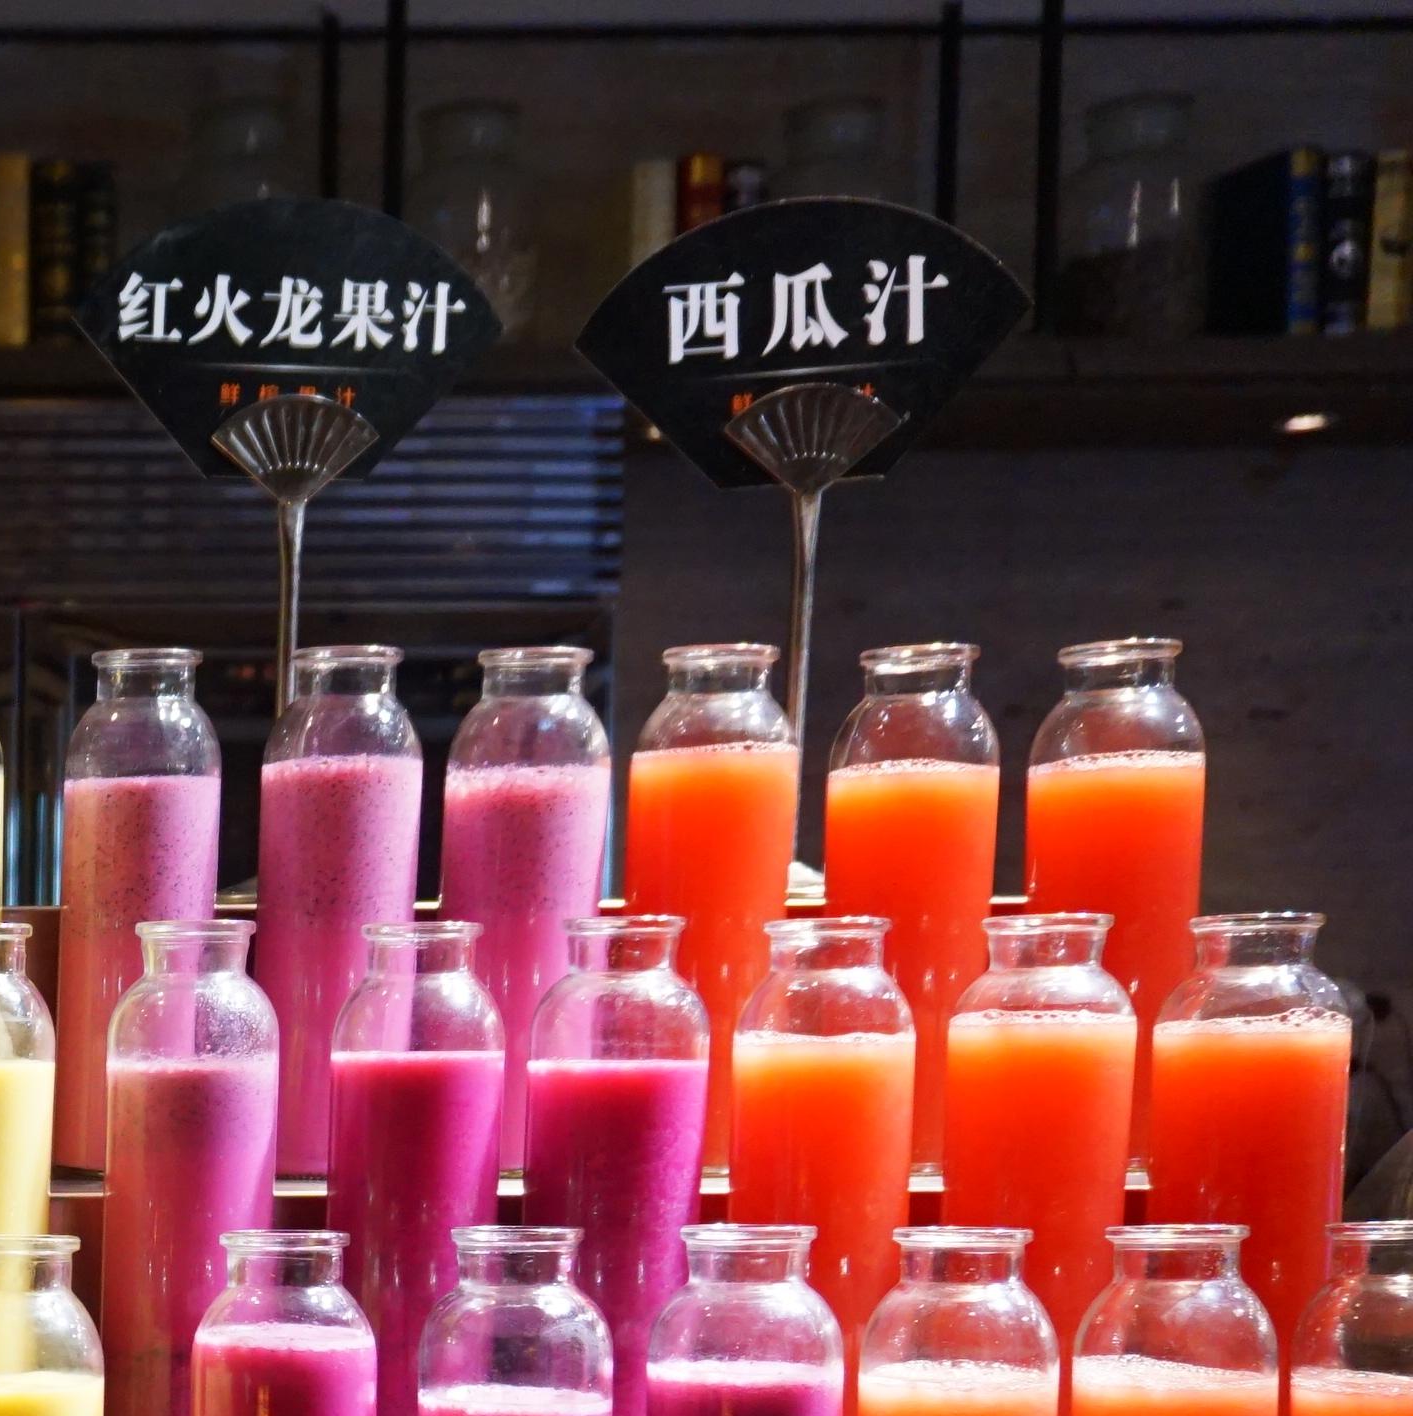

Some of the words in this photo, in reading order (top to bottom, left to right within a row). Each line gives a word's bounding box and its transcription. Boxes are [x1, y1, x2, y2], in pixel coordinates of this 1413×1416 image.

[117, 271, 466, 355] 红火龙果汁
[662, 254, 949, 364] 西瓜汁
